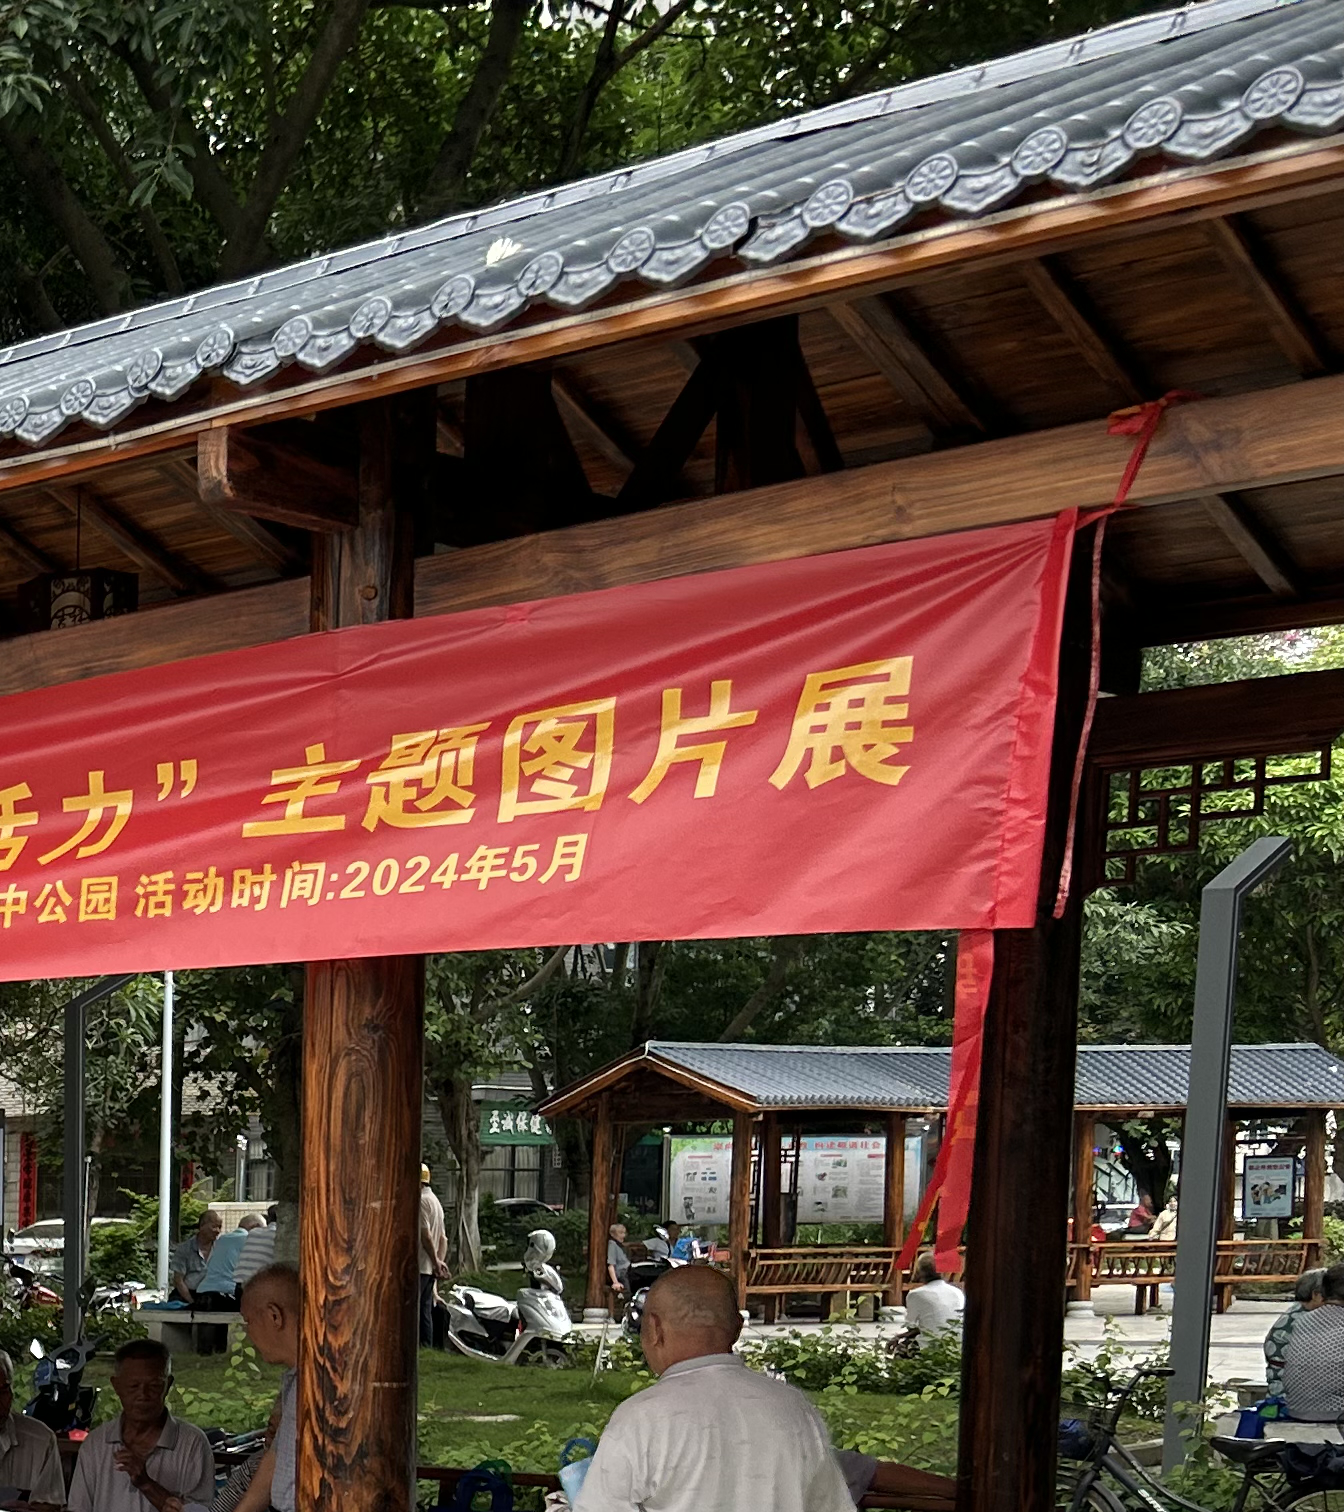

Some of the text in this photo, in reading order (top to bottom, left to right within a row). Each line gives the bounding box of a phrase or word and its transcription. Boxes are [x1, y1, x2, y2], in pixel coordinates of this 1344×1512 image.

[243, 656, 915, 840] 主题图片展
